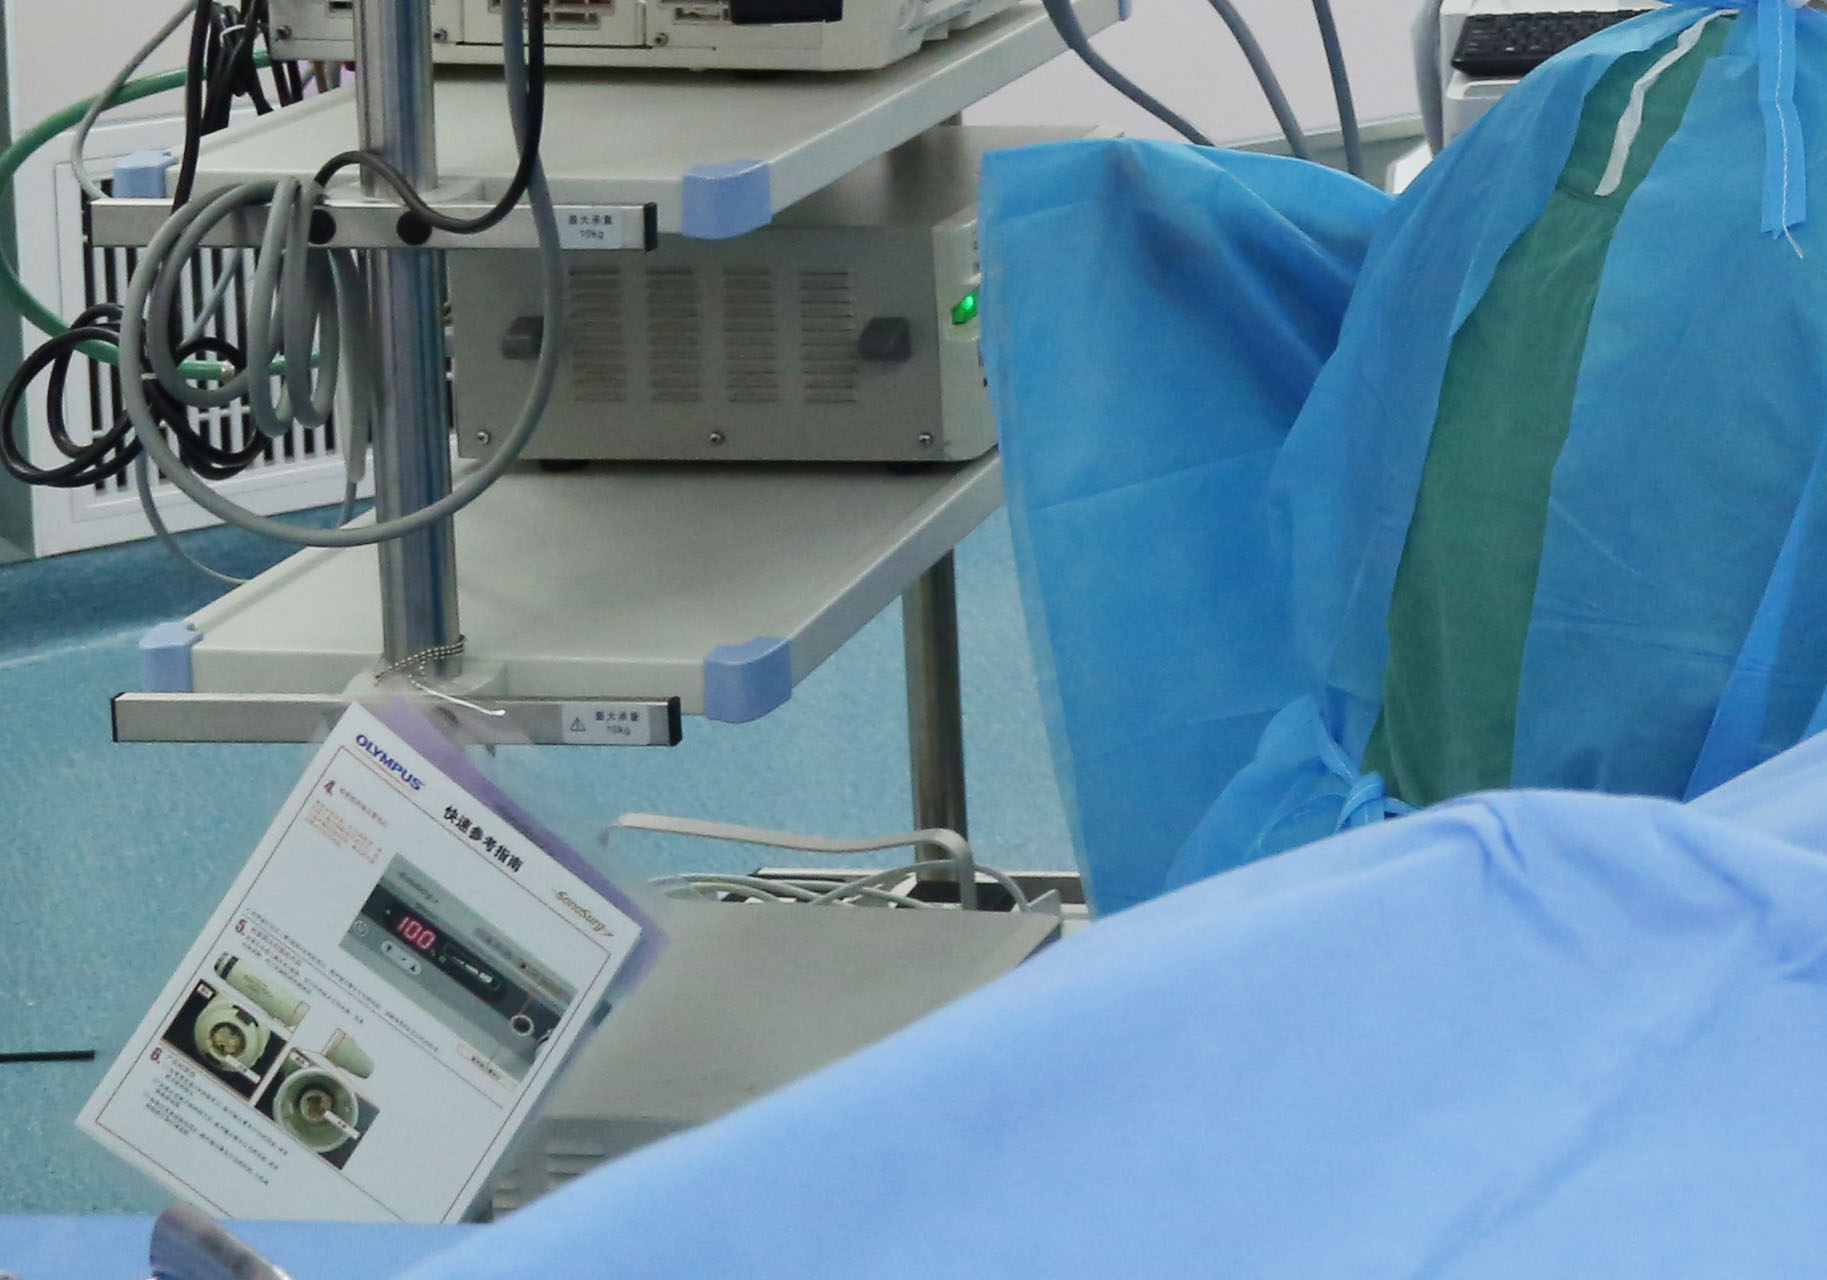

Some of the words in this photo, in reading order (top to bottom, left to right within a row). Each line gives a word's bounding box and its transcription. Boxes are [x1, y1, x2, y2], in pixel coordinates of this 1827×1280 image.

[355, 733, 426, 791] OLYMPUS
[442, 805, 524, 873] 快速参考指南
[396, 916, 437, 951] 100
